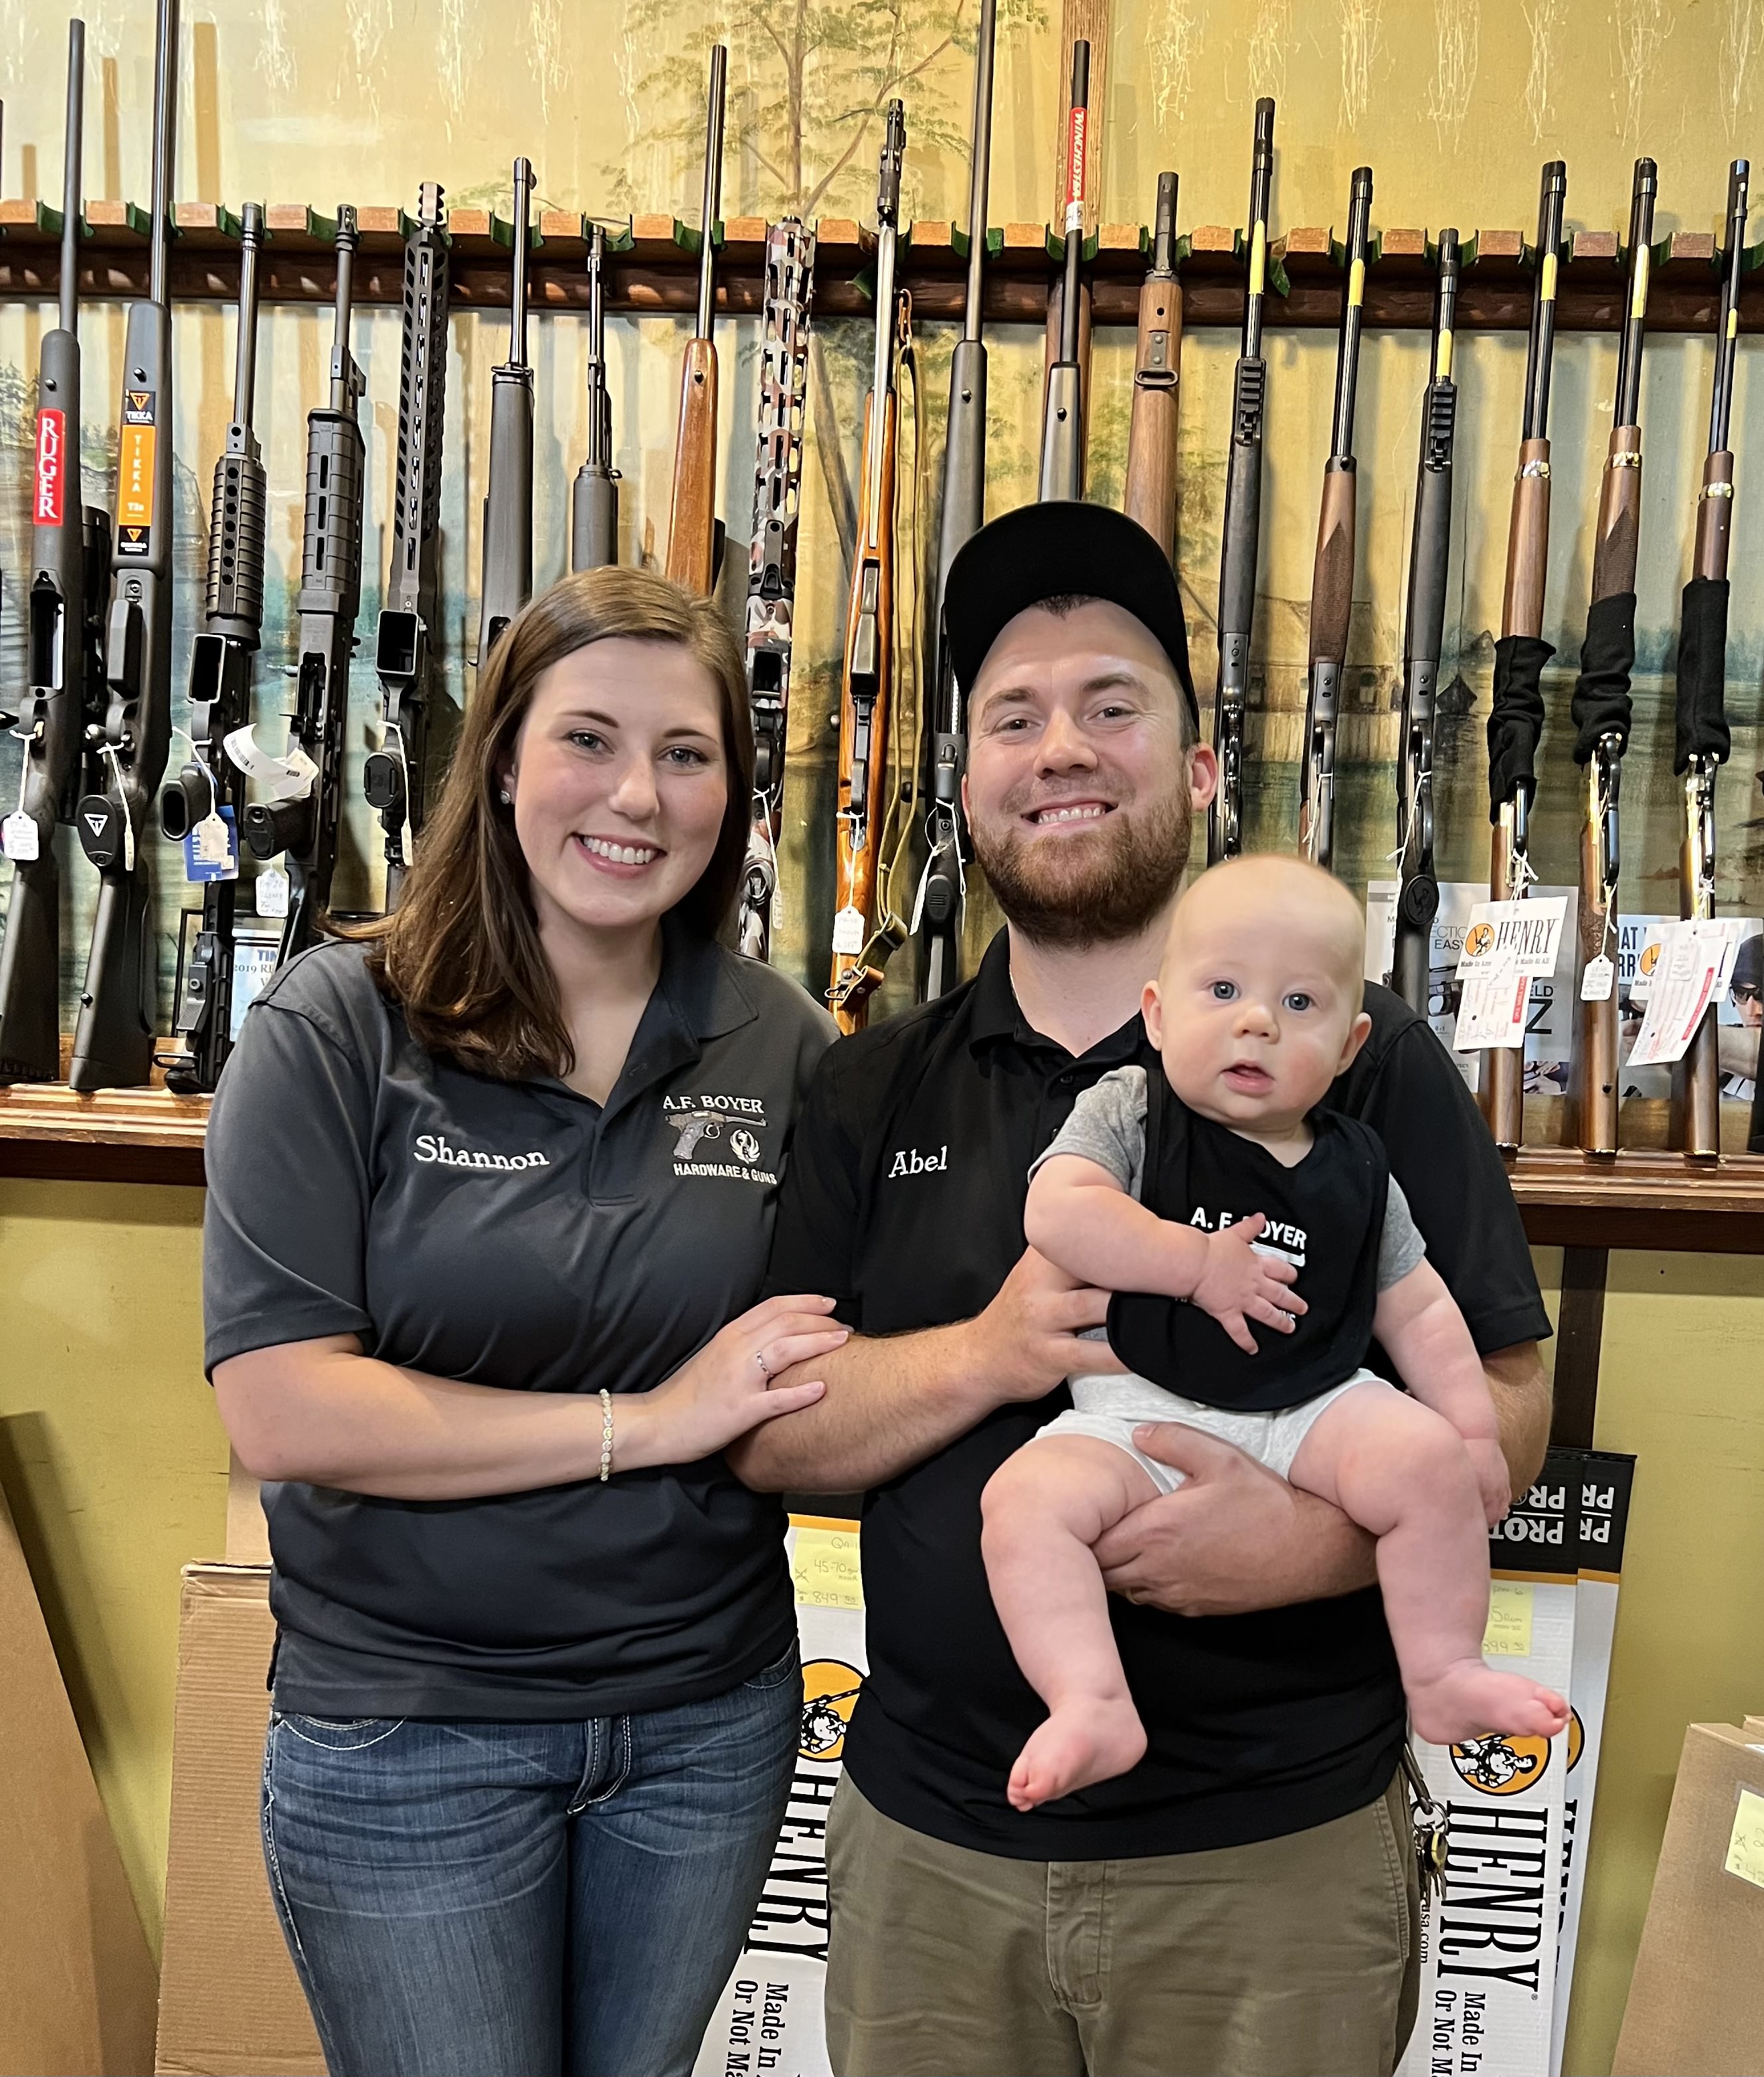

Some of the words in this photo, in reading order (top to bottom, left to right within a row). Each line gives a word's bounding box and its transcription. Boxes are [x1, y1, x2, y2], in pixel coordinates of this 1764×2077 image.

[1072, 111, 1085, 197] WINCHESTER
[38, 417, 58, 518] RUGER
[132, 434, 142, 492] TIKKA
[1496, 918, 1557, 955] HENRY
[1619, 954, 1640, 977] RR
[663, 1095, 696, 1110] A.F.
[700, 1095, 764, 1114] BOYER
[413, 1134, 550, 1171] Shannon
[888, 1146, 948, 1178] Abel
[673, 1163, 743, 1180] HARDWARE
[742, 1167, 750, 1180] &
[750, 1168, 778, 1185] GUNS
[1190, 1206, 1213, 1229] A.
[1243, 1216, 1307, 1250] OYER
[814, 1558, 847, 1573] 45-70
[812, 1590, 839, 1605] 849
[1437, 1799, 1549, 1992] HENRY
[734, 1980, 758, 2004] Or
[1435, 1989, 1457, 2013] Or
[729, 2009, 755, 2046] Not
[760, 1982, 789, 2040] Made
[1462, 1991, 1486, 2046] Made
[1432, 2017, 1455, 2052] Not
[757, 2046, 782, 2068] In
[1431, 2056, 1453, 2077] M
[1460, 2051, 1482, 2073] In
